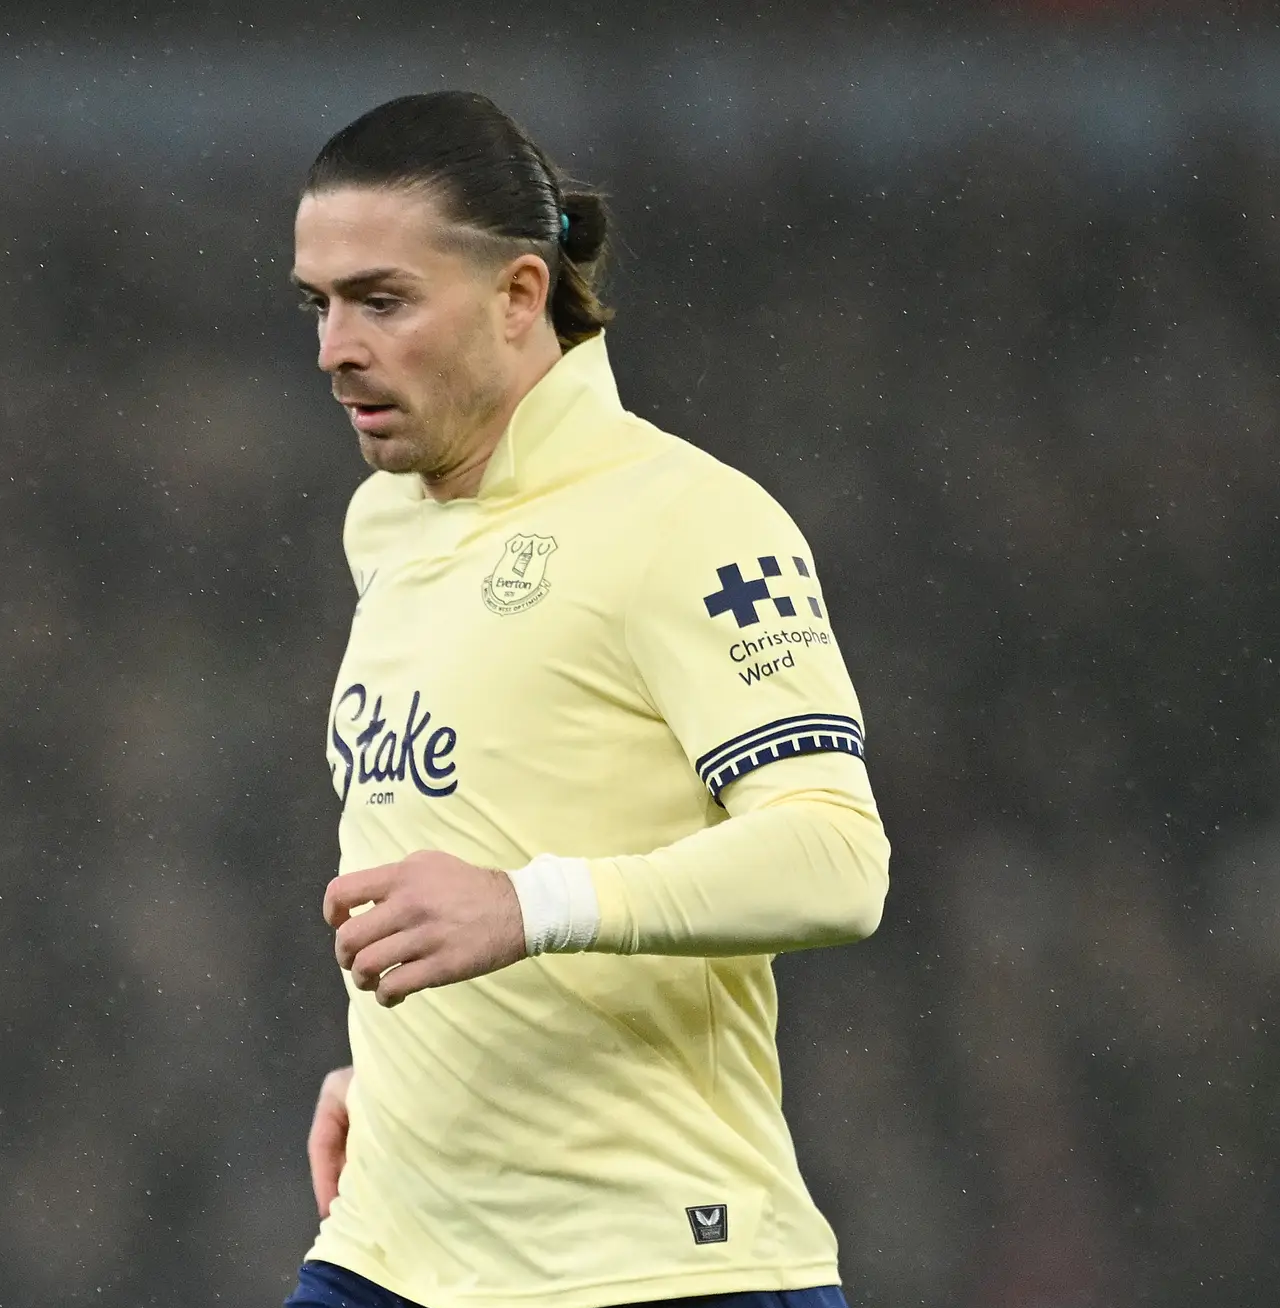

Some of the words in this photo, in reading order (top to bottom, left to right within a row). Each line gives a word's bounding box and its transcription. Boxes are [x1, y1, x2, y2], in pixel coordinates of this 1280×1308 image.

[496, 577, 532, 589] Everton
[738, 649, 795, 687] Ward
[332, 683, 458, 812] Stake
